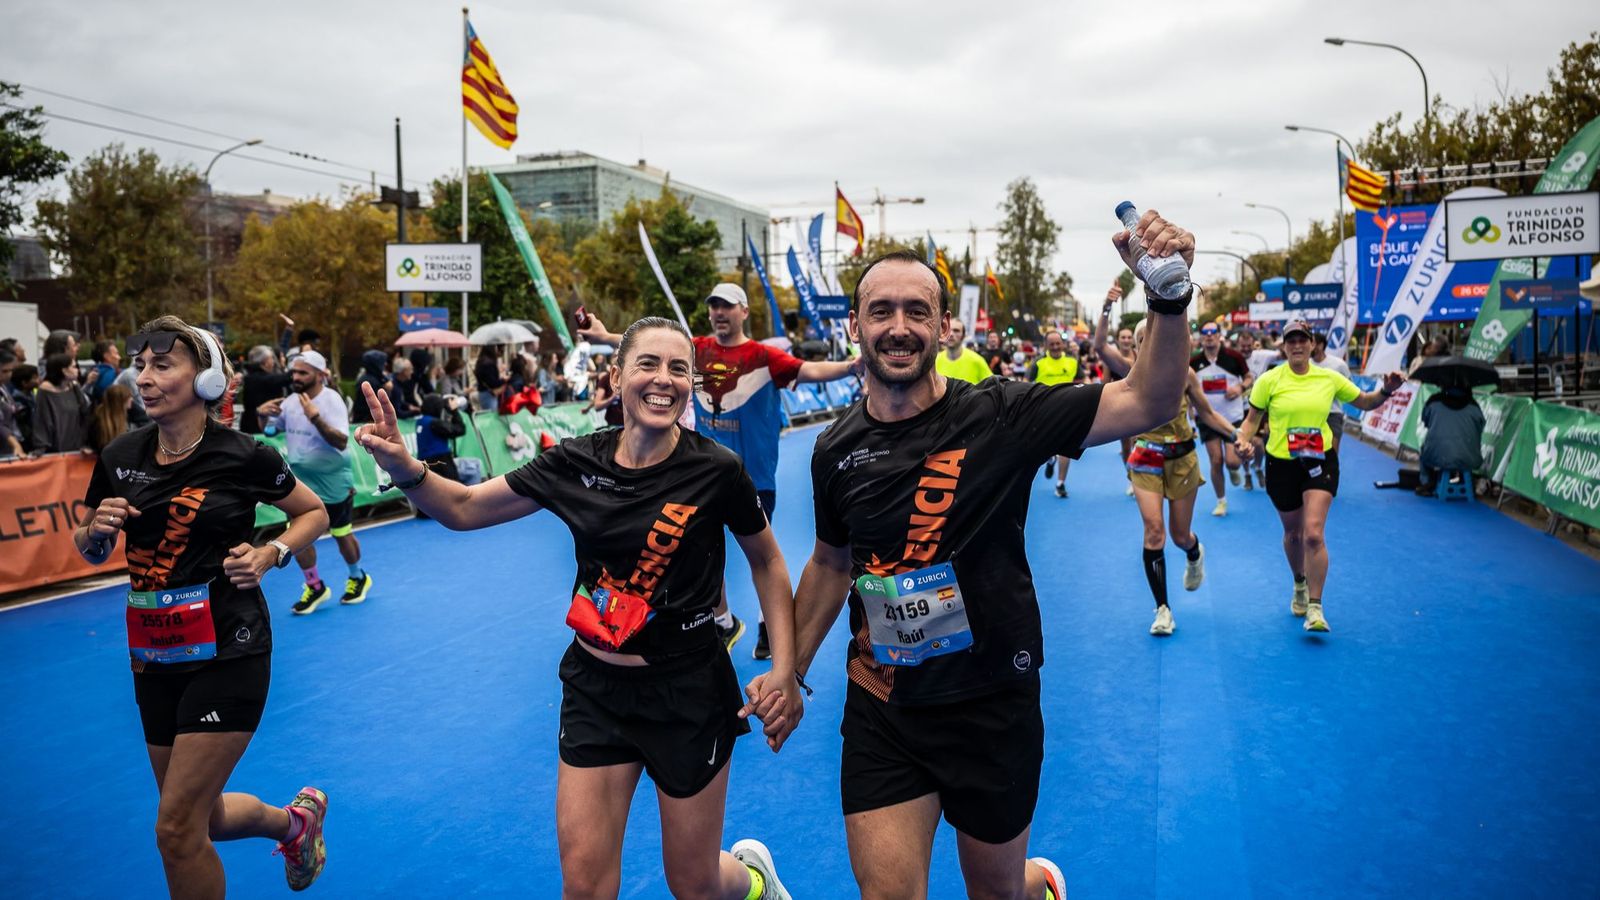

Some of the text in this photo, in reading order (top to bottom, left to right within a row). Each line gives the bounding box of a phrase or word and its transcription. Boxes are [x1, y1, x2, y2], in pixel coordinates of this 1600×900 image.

[1507, 205, 1584, 218] FUNDACIÓN
[1507, 217, 1585, 233] TRINIDAD
[1508, 230, 1585, 246] ALFONSO
[1370, 242, 1409, 255] SIGUE
[424, 263, 472, 271] TRINIDAD
[1370, 256, 1387, 268] LA
[1406, 227, 1446, 305] ZURIC
[424, 273, 472, 281] ALFONSO
[1304, 291, 1337, 301] ZURICH
[1473, 285, 1490, 296] OC
[817, 303, 845, 311] ZURICH
[1560, 445, 1600, 480] TRINIDA
[916, 571, 948, 585] ZURICH
[175, 590, 202, 600] ZURICH
[140, 611, 184, 628] 25578
[897, 627, 925, 644] Raúl
